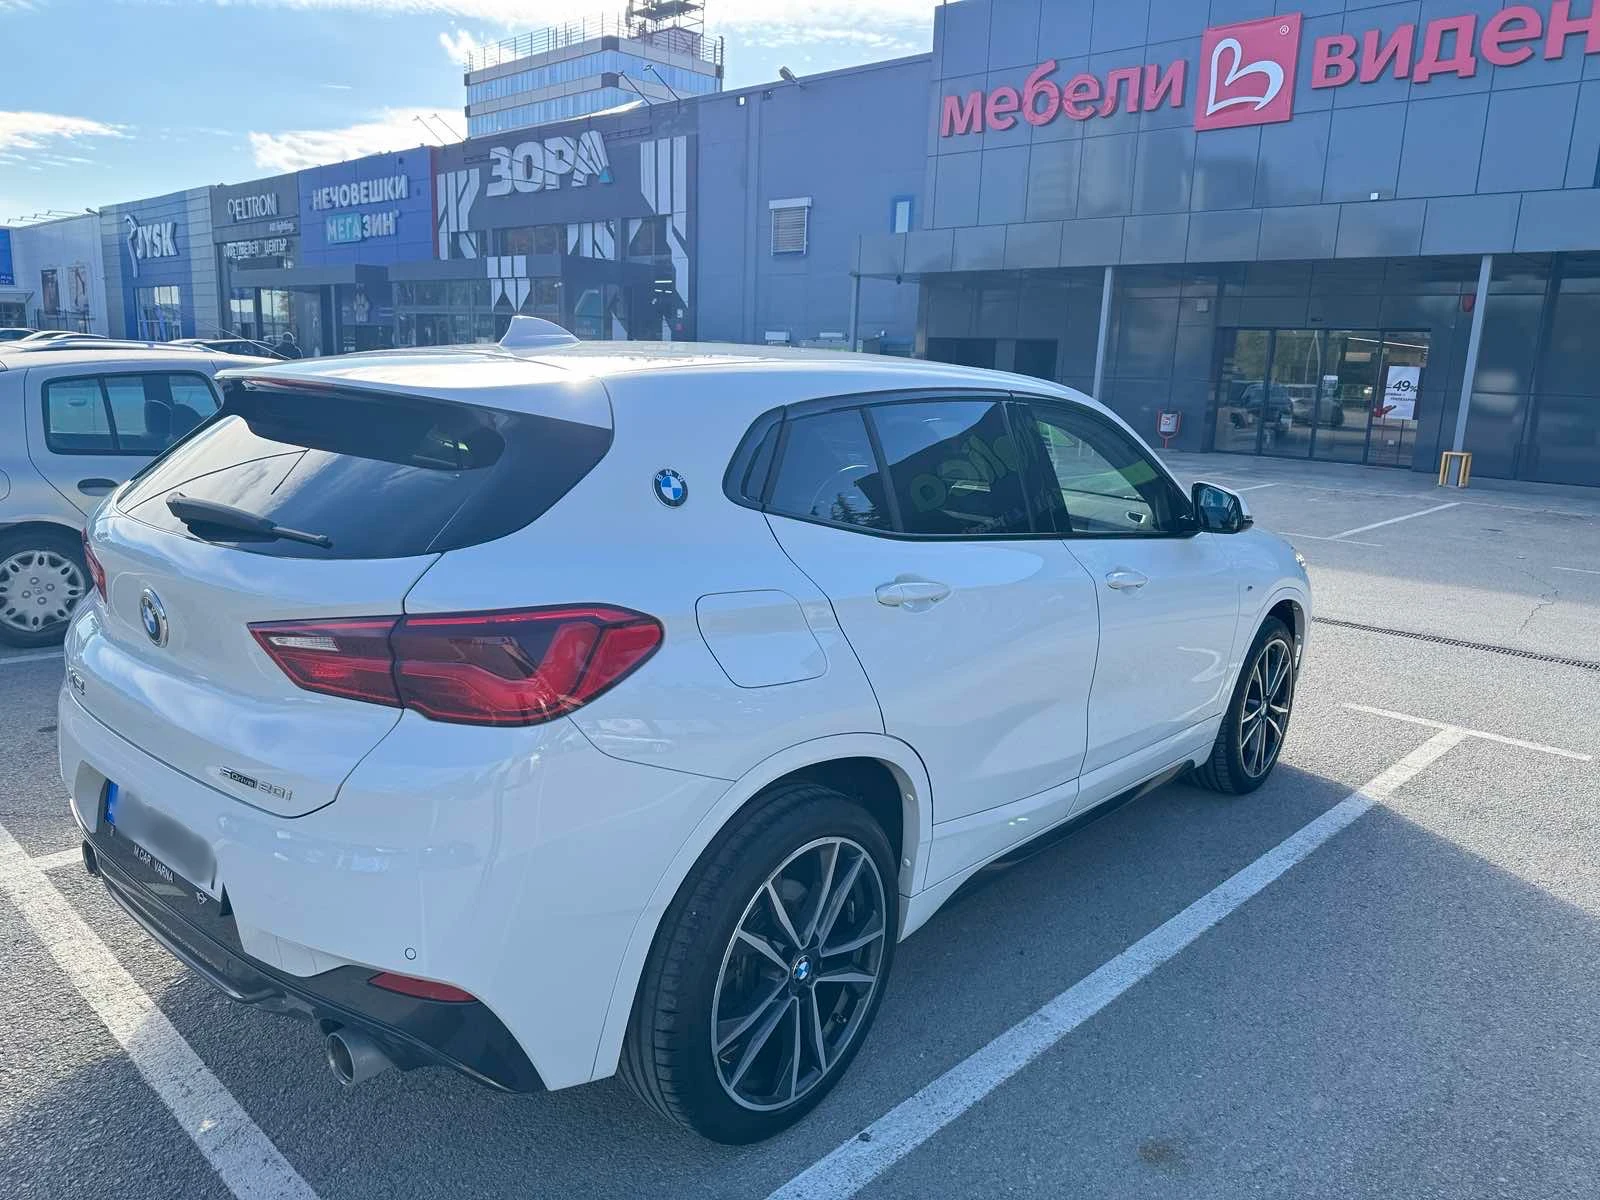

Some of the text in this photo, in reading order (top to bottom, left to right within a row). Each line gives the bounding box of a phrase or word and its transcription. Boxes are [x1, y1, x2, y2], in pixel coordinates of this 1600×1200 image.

[941, 59, 1185, 137] мебели
[486, 130, 613, 197] ЗОРА
[312, 174, 408, 210] НЕЧОВЕШКИ
[137, 222, 178, 259] JYSK
[153, 860, 174, 884] VARNA
